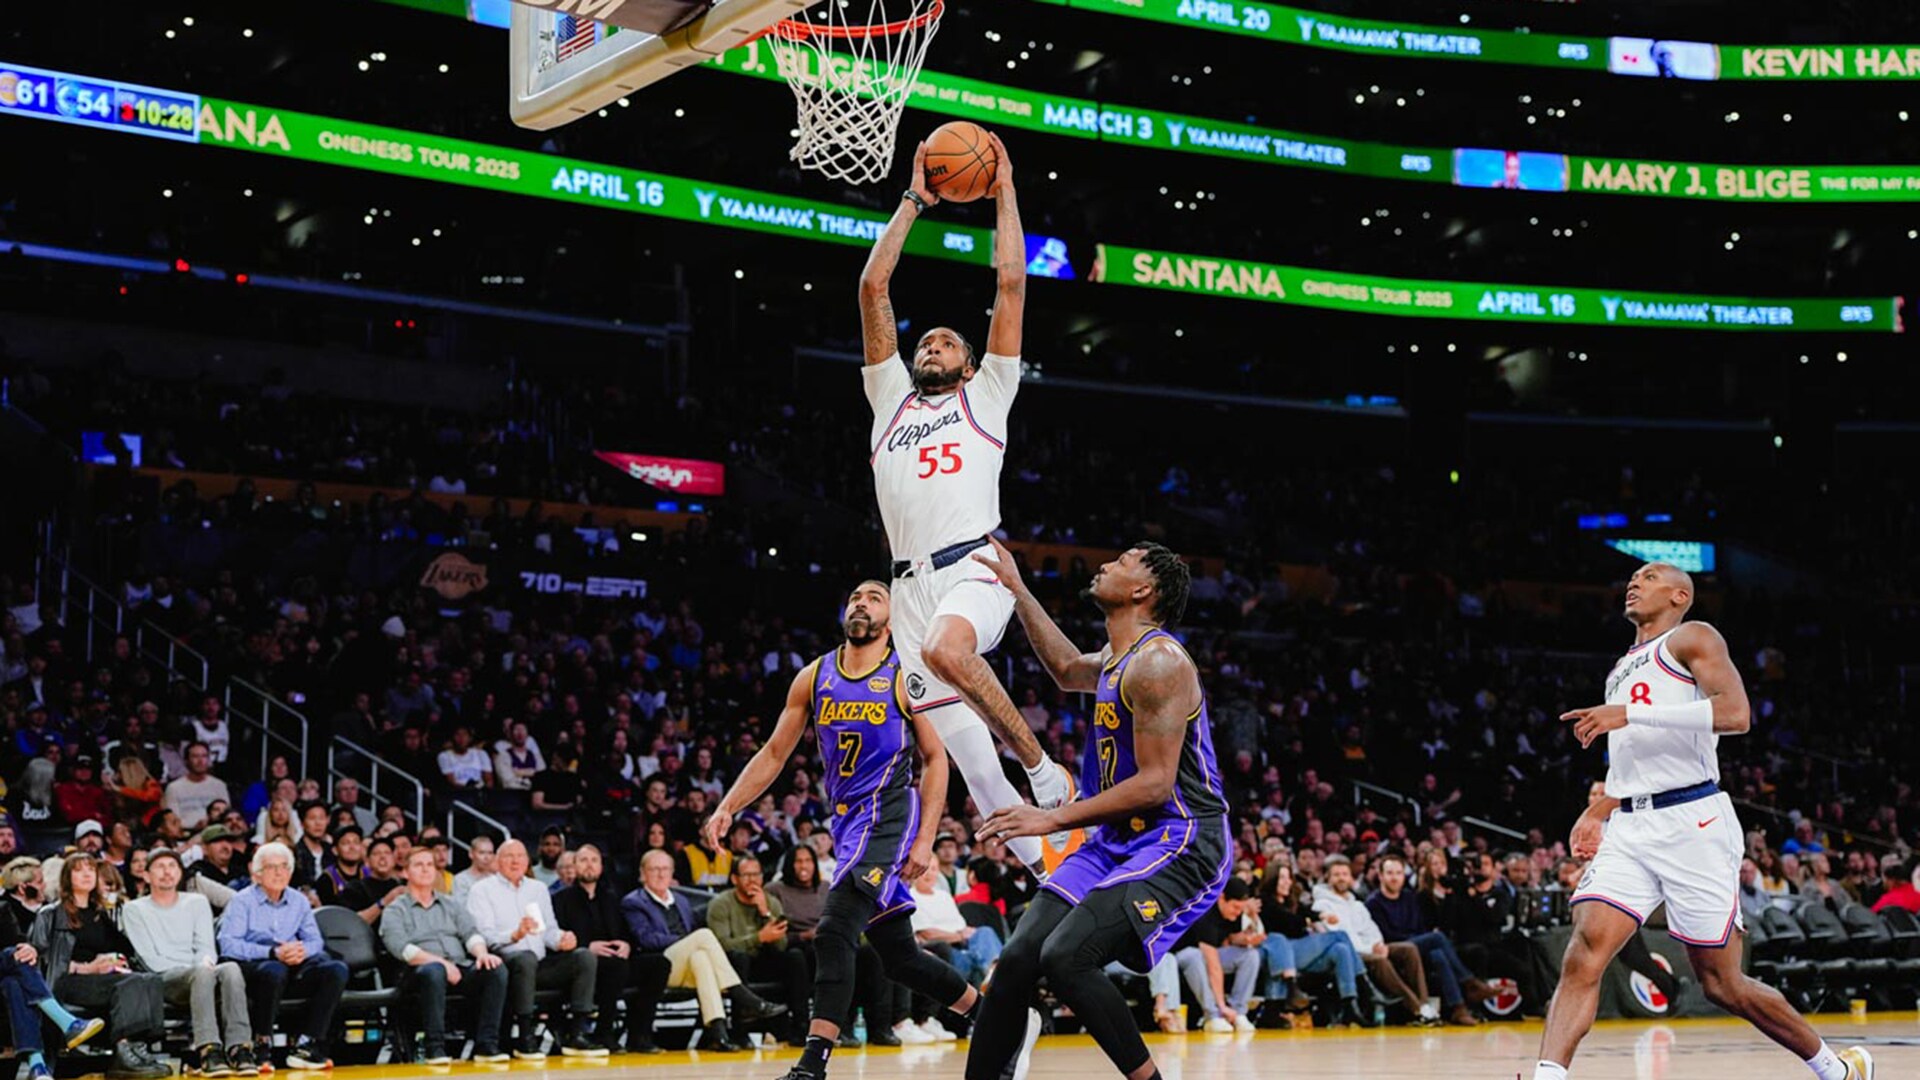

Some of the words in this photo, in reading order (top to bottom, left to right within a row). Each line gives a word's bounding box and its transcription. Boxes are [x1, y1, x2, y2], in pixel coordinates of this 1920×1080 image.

[1176, 0, 1240, 27] APRIL
[1242, 6, 1271, 32] 20
[1401, 31, 1482, 55] THEATER
[1741, 48, 1844, 77] KEVIN
[16, 79, 49, 108] 61
[777, 45, 873, 94] BLIGE
[997, 97, 1032, 117] TOUR
[76, 89, 112, 118] 54
[120, 104, 135, 121] 3
[135, 99, 194, 131] 10:28
[1043, 102, 1133, 136] MARCH
[1137, 117, 1153, 139] 3
[200, 103, 291, 151] ANA
[318, 131, 413, 163] ONENESS
[418, 146, 470, 172] TOUR
[475, 156, 521, 180] 2025
[1273, 138, 1346, 166] THEATER
[551, 166, 630, 202] APRIL
[636, 180, 665, 207] 16
[1582, 161, 1676, 193] MARY
[1685, 166, 1707, 196] J.
[1716, 168, 1811, 199] BLIGE
[1850, 176, 1879, 191] FOR
[1133, 252, 1286, 299] SANTANA
[1302, 278, 1369, 302] ONENESS
[1372, 285, 1412, 305] TOUR
[1415, 290, 1453, 308] 2025
[1477, 290, 1545, 315] APRIL
[1549, 293, 1576, 317] 16
[1710, 304, 1793, 325] THEATER
[887, 410, 963, 452] Clippers
[918, 442, 963, 479] 55
[520, 571, 561, 594] 710
[586, 577, 647, 599] ESPN
[1630, 682, 1652, 705] 8
[818, 697, 888, 725] LAKERS
[838, 731, 862, 777] 7
